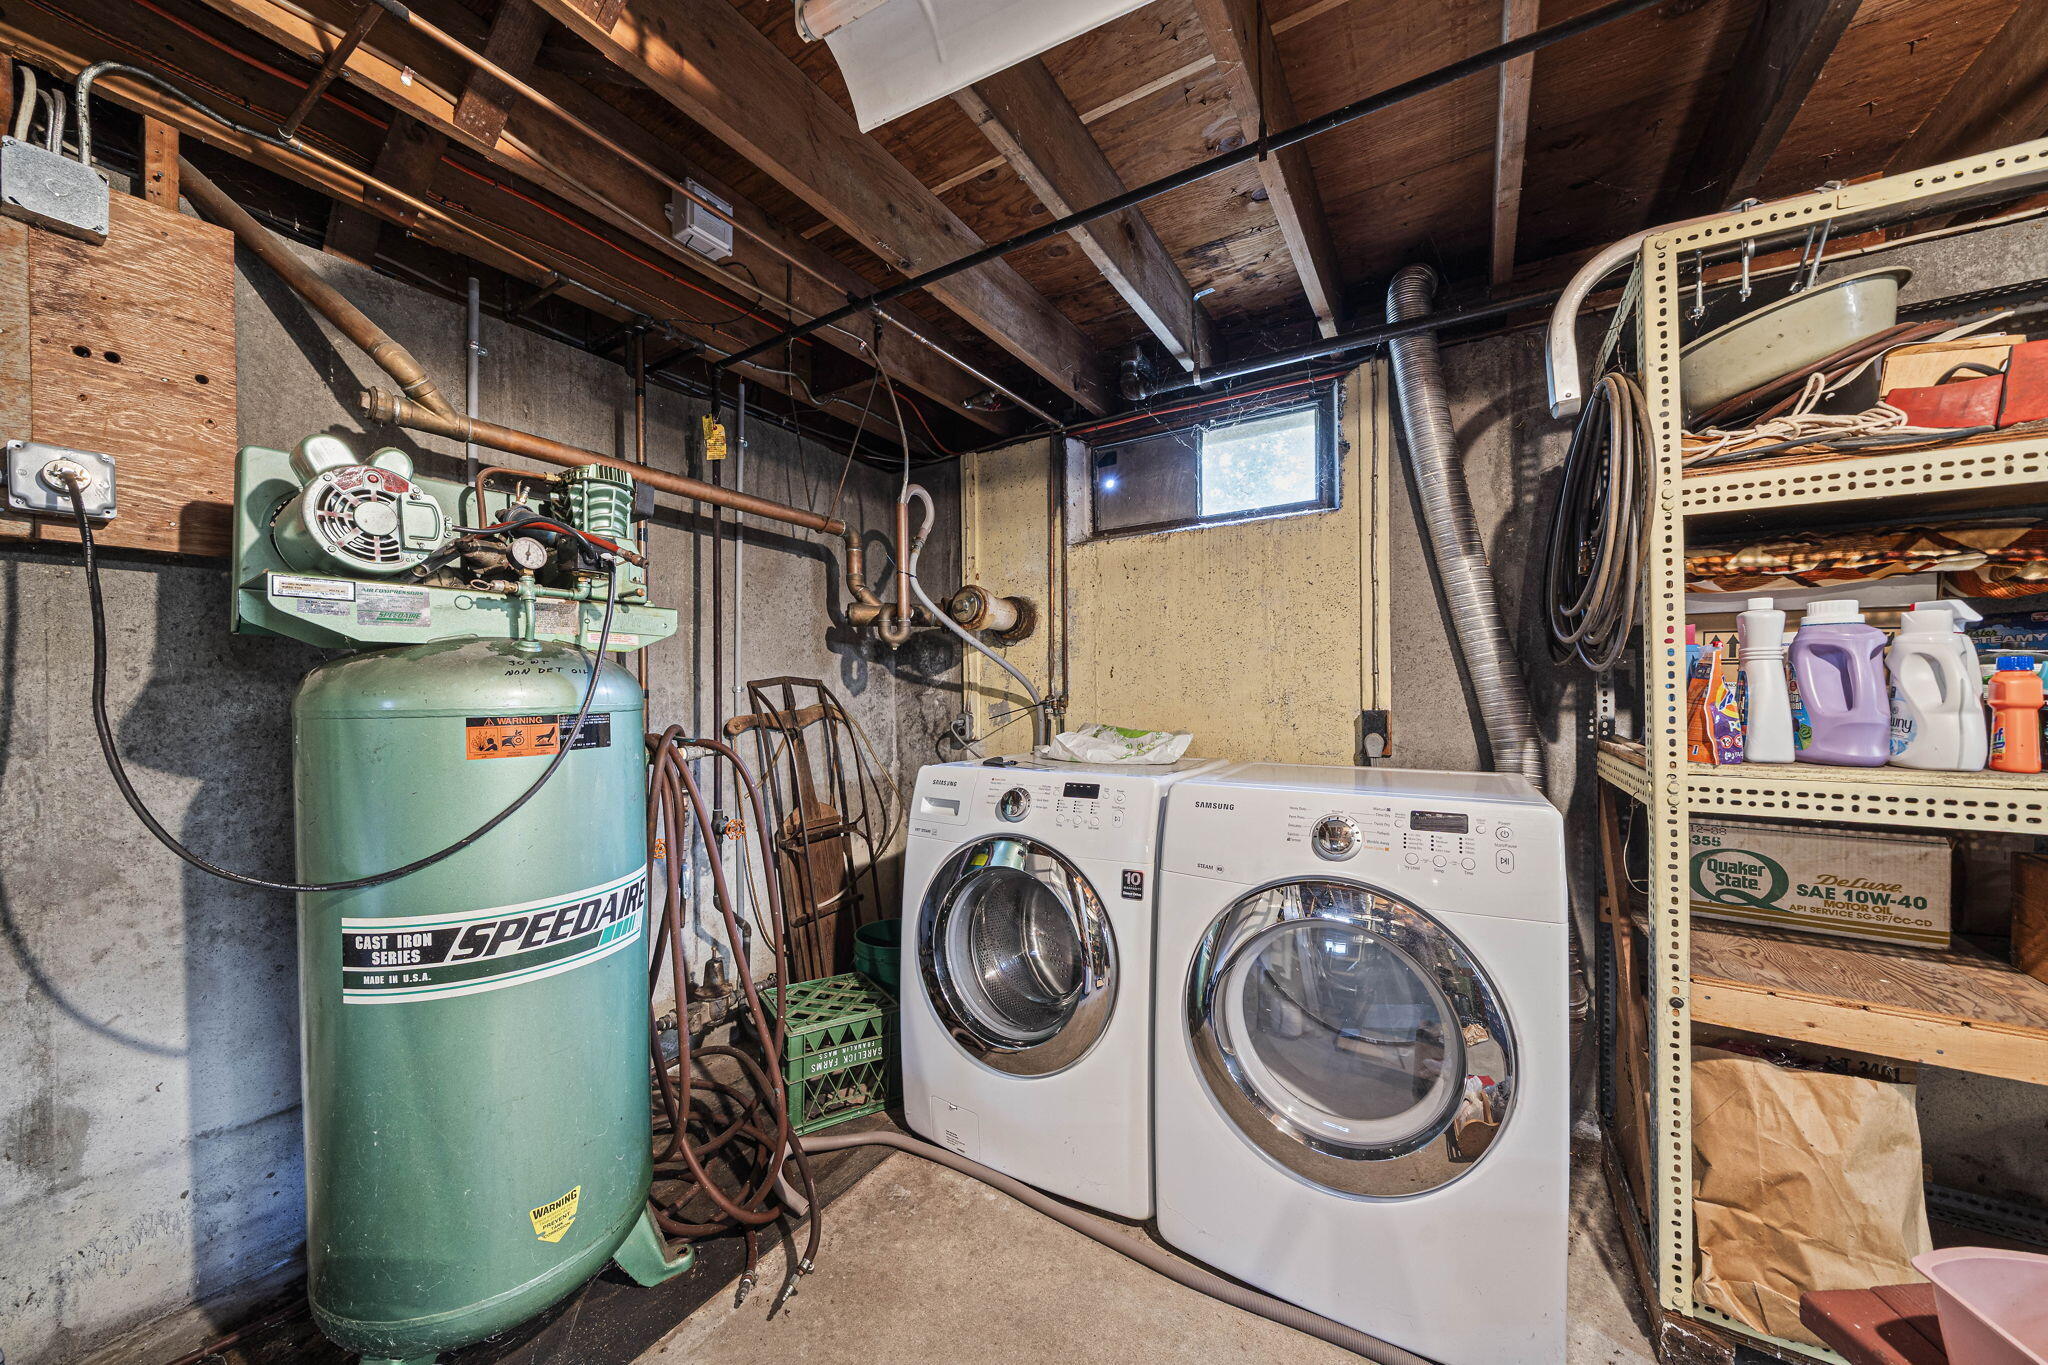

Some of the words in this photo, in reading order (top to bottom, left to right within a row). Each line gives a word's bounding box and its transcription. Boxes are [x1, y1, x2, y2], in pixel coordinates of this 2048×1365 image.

[505, 668, 531, 676] NON
[496, 716, 543, 725] WARNING
[932, 779, 958, 787] SAMSUNG
[1195, 801, 1235, 811] SAMSUNG
[1706, 858, 1765, 877] Quaker
[1124, 872, 1141, 886] 10
[1796, 884, 1836, 900] SAE
[1843, 889, 1928, 910] 10W-40
[1823, 900, 1869, 912] MOTOR
[1871, 905, 1893, 915] OIL
[450, 876, 646, 962] SPEEDAIRE
[1789, 904, 1807, 912] API
[1810, 906, 1853, 918] SERVICE
[1856, 912, 1933, 927] SG-SF/CC-CD
[355, 933, 388, 950] CAST
[397, 932, 433, 948] IRON
[371, 949, 421, 965] SERIES
[363, 975, 385, 985] MADE
[388, 975, 398, 984] IN
[403, 973, 432, 983] U.S.A.
[819, 1050, 838, 1060] MASS
[842, 1041, 875, 1054] FRANKLIN
[843, 1047, 882, 1064] GARELICK
[811, 1058, 838, 1073] FARMS
[532, 1189, 577, 1220] WARNING
[542, 1211, 571, 1230] PREVENT
